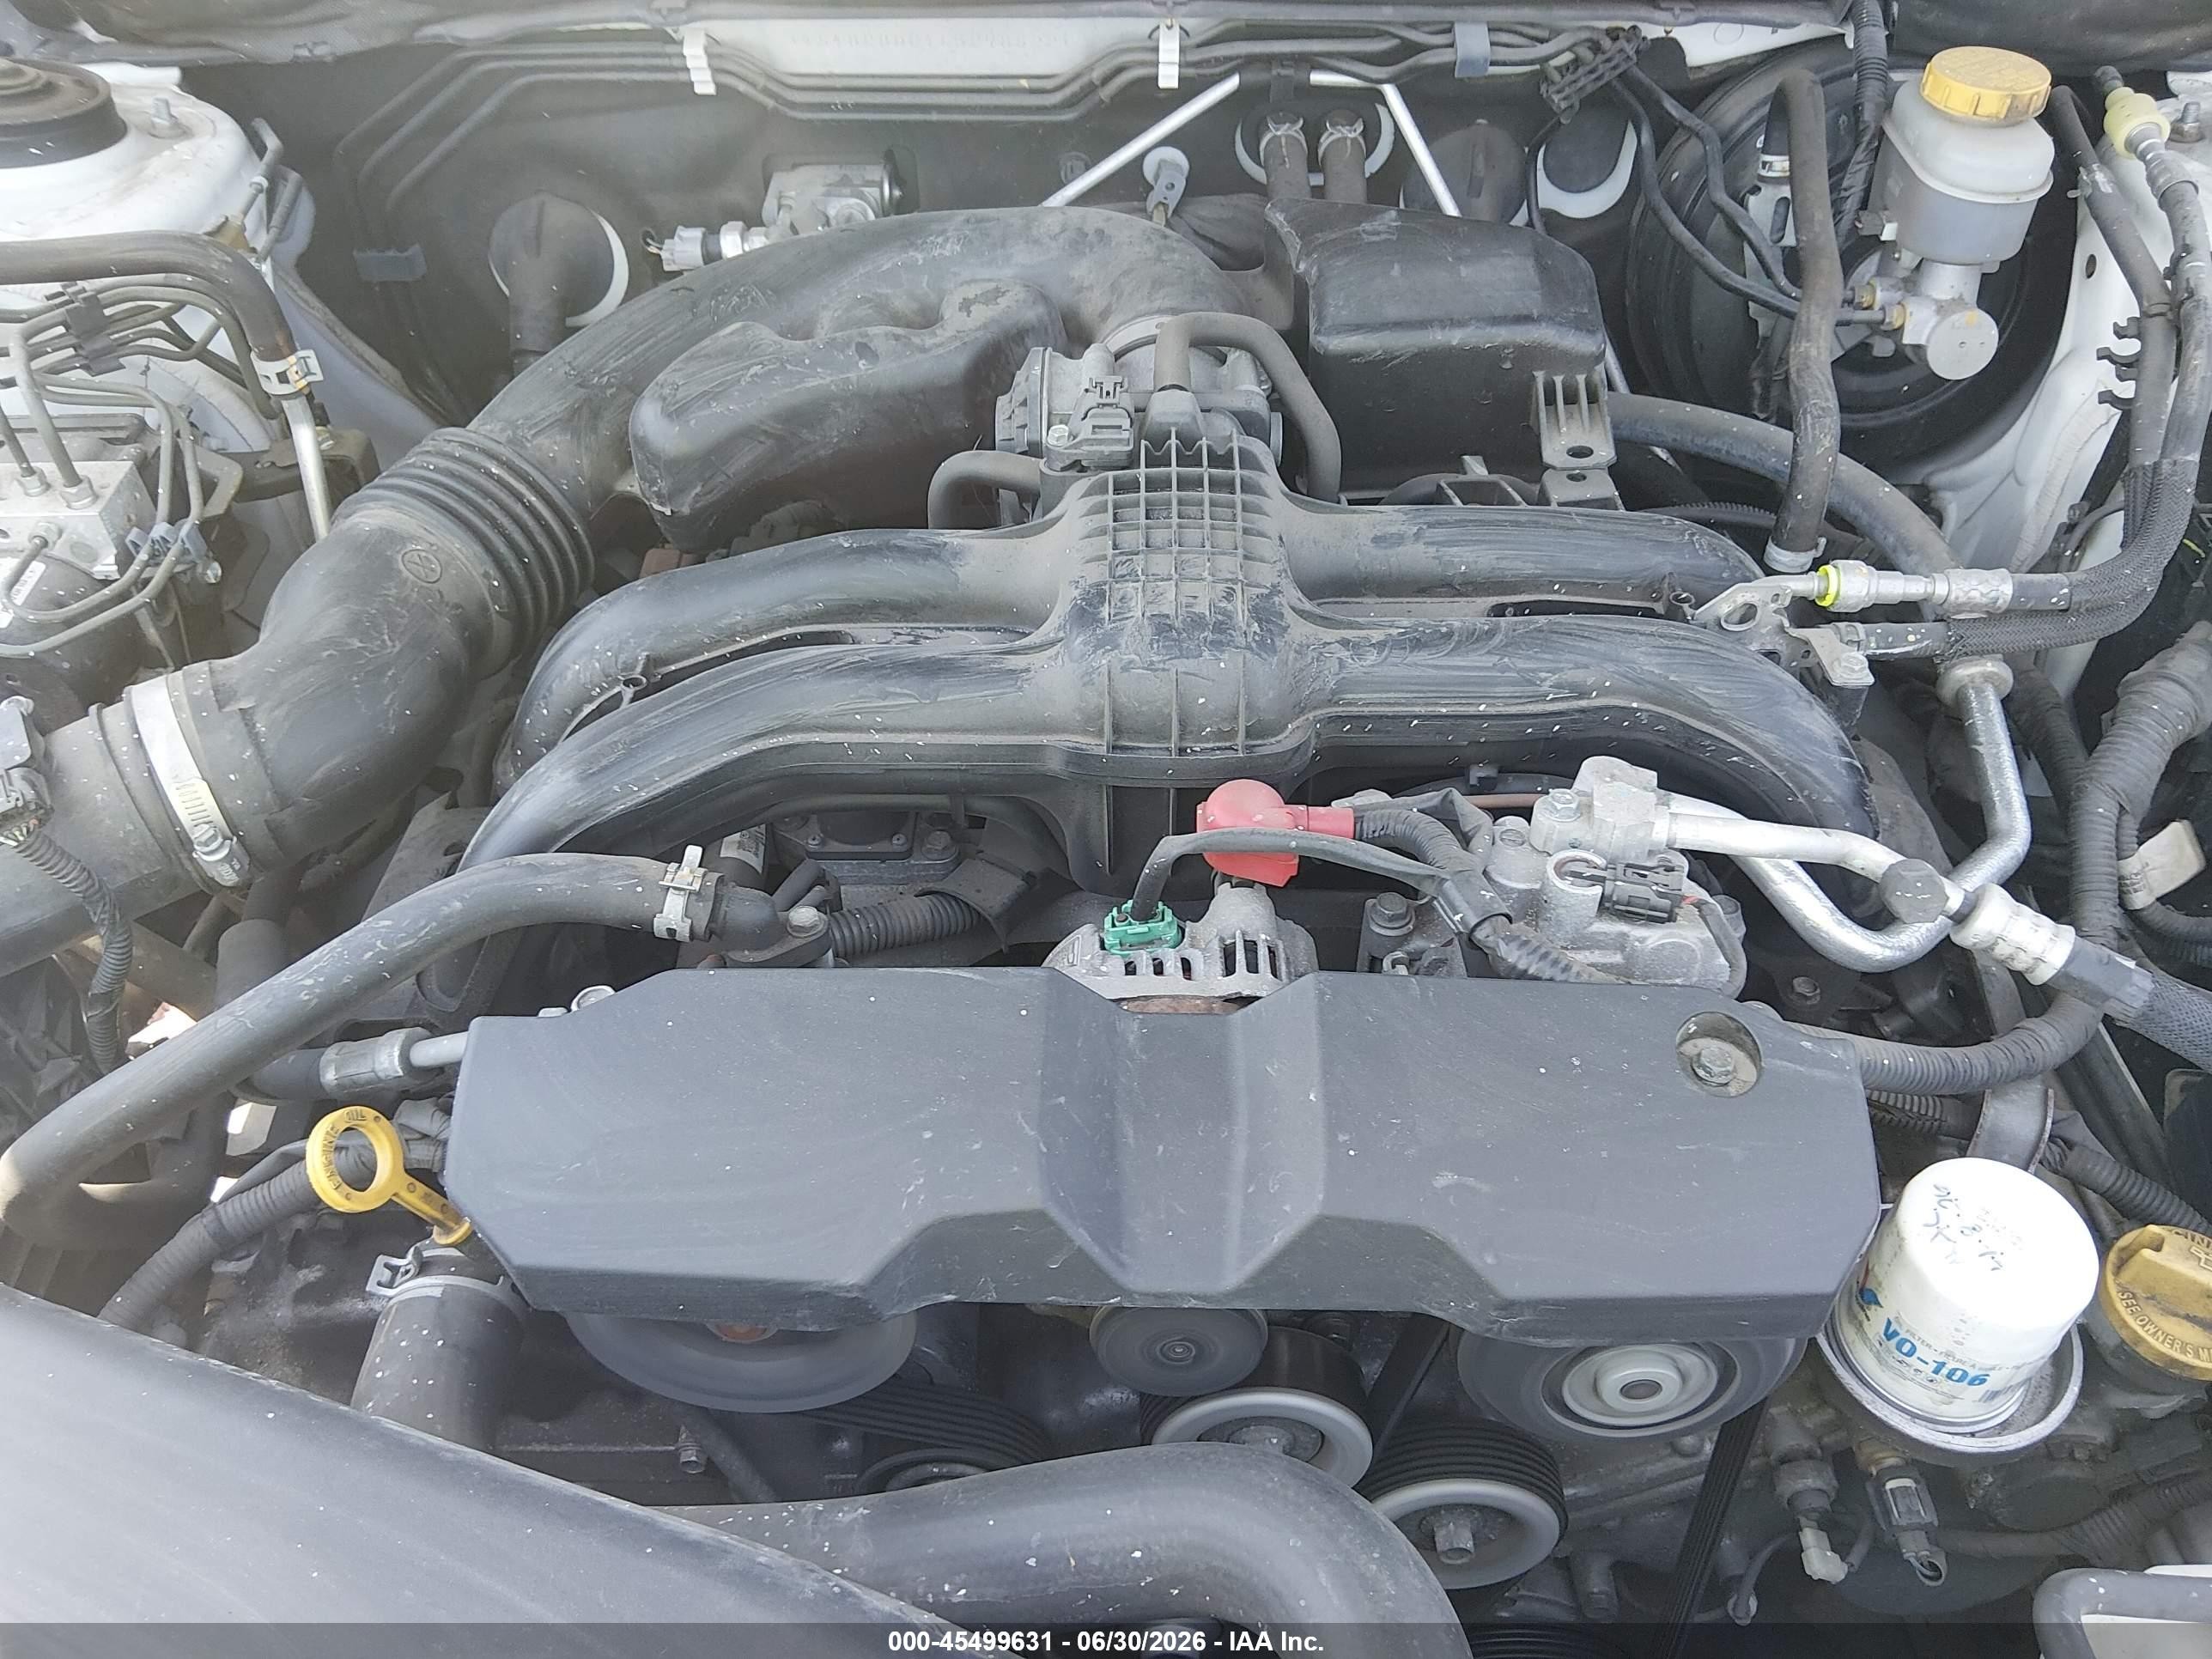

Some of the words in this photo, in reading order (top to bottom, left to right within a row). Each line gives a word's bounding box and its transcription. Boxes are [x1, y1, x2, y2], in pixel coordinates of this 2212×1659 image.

[1881, 1317, 1990, 1387] VO-106
[2118, 1291, 2142, 1316] SEE
[2136, 1314, 2194, 1358] OWNER'S
